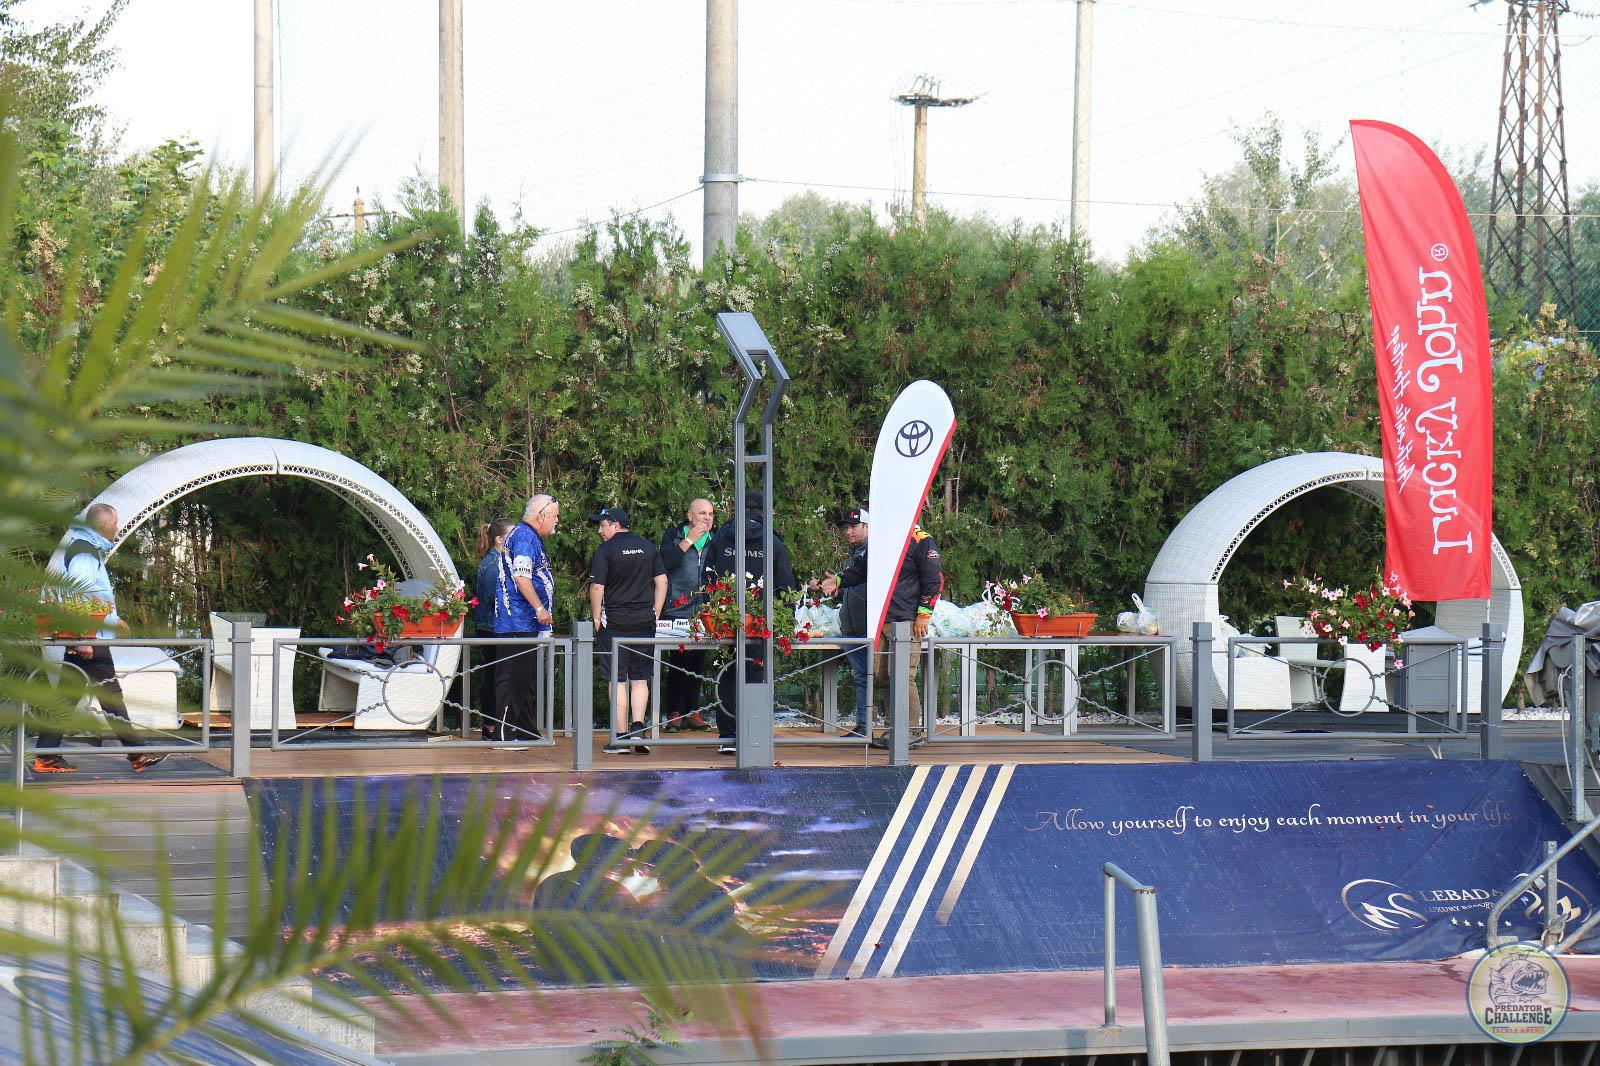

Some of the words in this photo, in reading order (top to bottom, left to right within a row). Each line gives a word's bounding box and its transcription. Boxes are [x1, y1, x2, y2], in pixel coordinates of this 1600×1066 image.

[724, 547, 765, 558] SIMS
[1024, 808, 1104, 832] Allow
[1107, 805, 1195, 836] yourself
[1195, 816, 1212, 828] to
[1218, 813, 1270, 833] enjoy
[1276, 803, 1321, 826] each
[1326, 811, 1405, 825] moment
[1409, 810, 1430, 824] in
[1431, 811, 1478, 829] your
[1483, 800, 1514, 828] life
